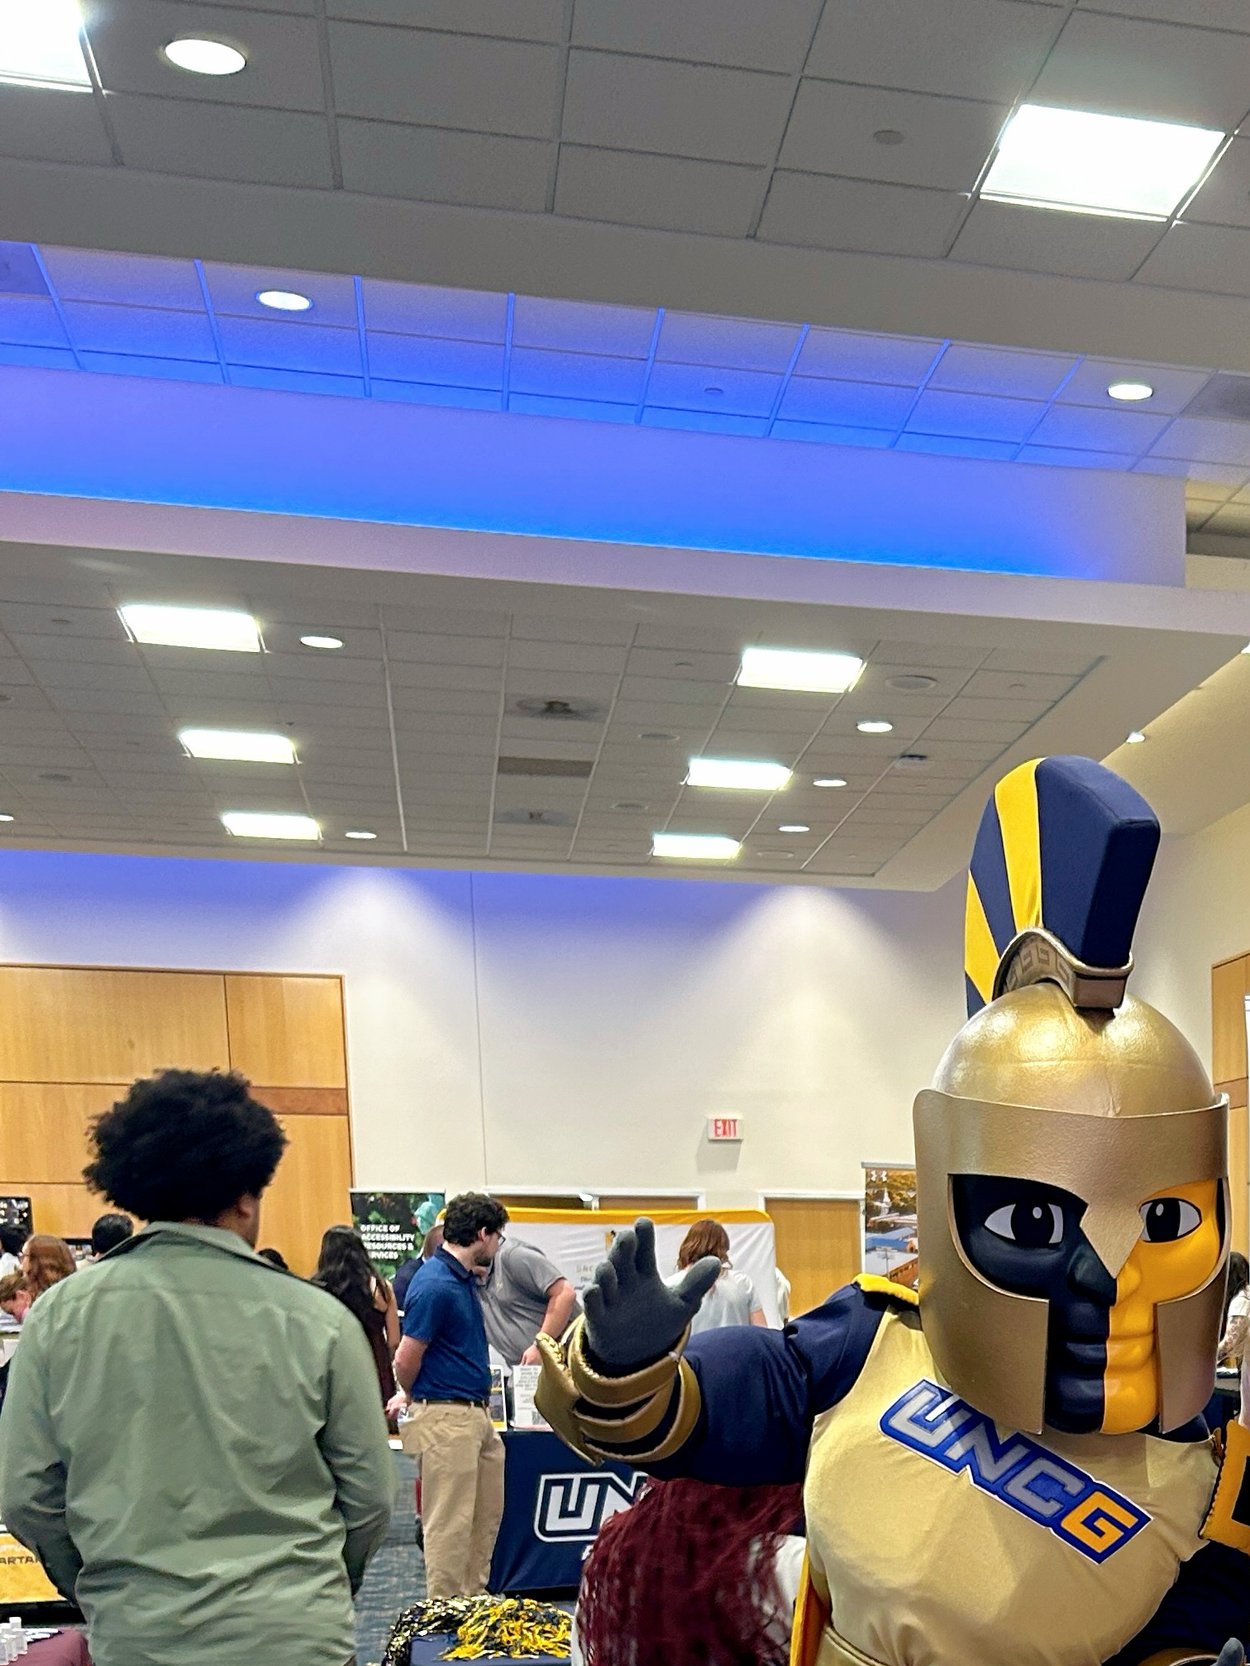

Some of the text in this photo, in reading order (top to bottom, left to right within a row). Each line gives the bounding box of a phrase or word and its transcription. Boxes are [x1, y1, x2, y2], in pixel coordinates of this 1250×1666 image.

[714, 1119, 737, 1137] EXIT
[360, 1224, 401, 1233] OFFICE OF
[361, 1233, 415, 1242] ACCESSIBILITY
[882, 1383, 1147, 1560] UNCG
